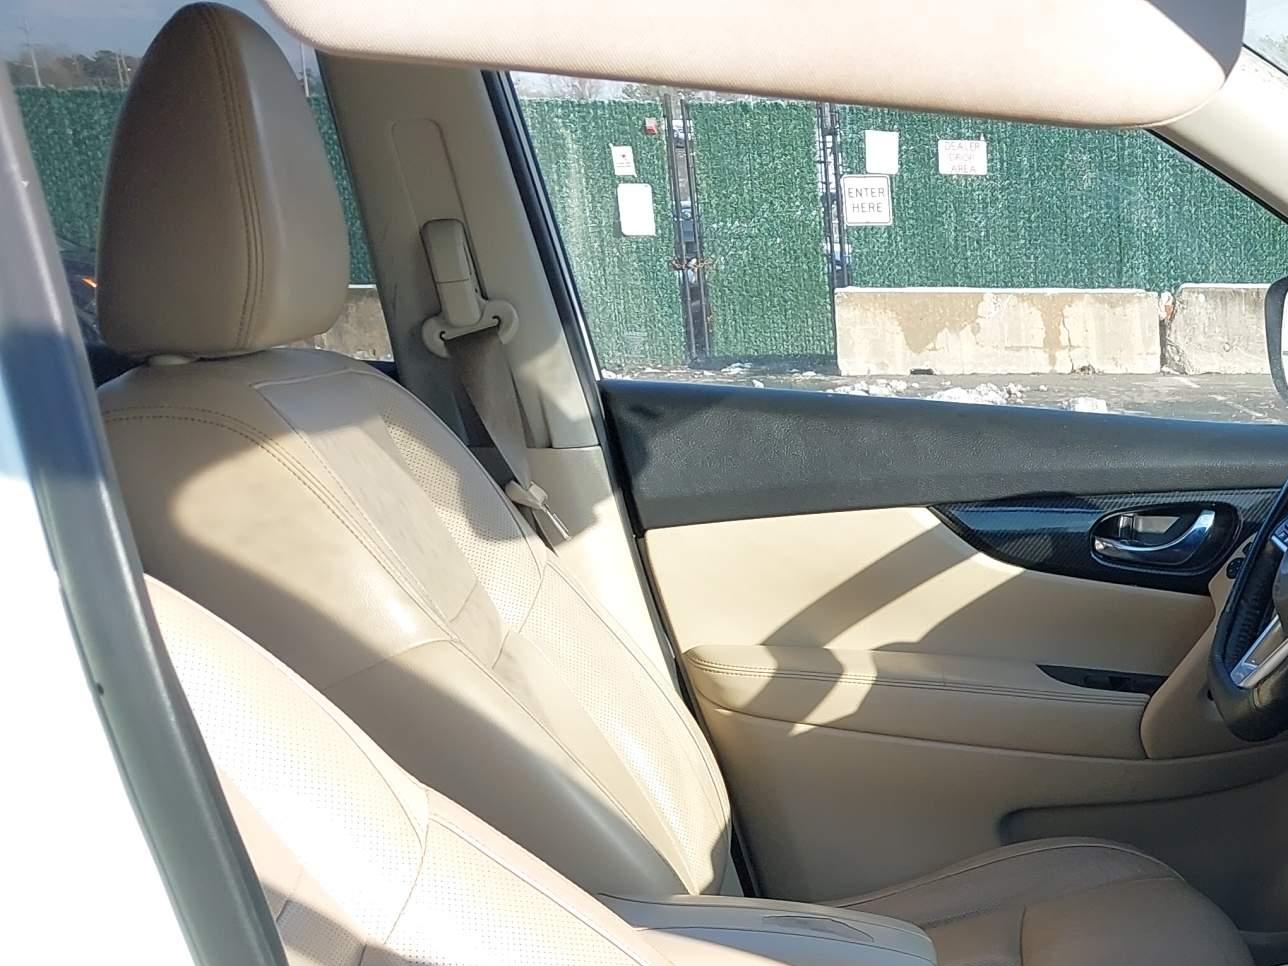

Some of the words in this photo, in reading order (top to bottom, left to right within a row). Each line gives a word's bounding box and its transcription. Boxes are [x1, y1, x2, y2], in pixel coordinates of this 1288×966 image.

[944, 141, 981, 151] DEALER
[952, 164, 976, 174] AREA
[847, 186, 886, 199] ENTER
[852, 201, 884, 214] HERE
